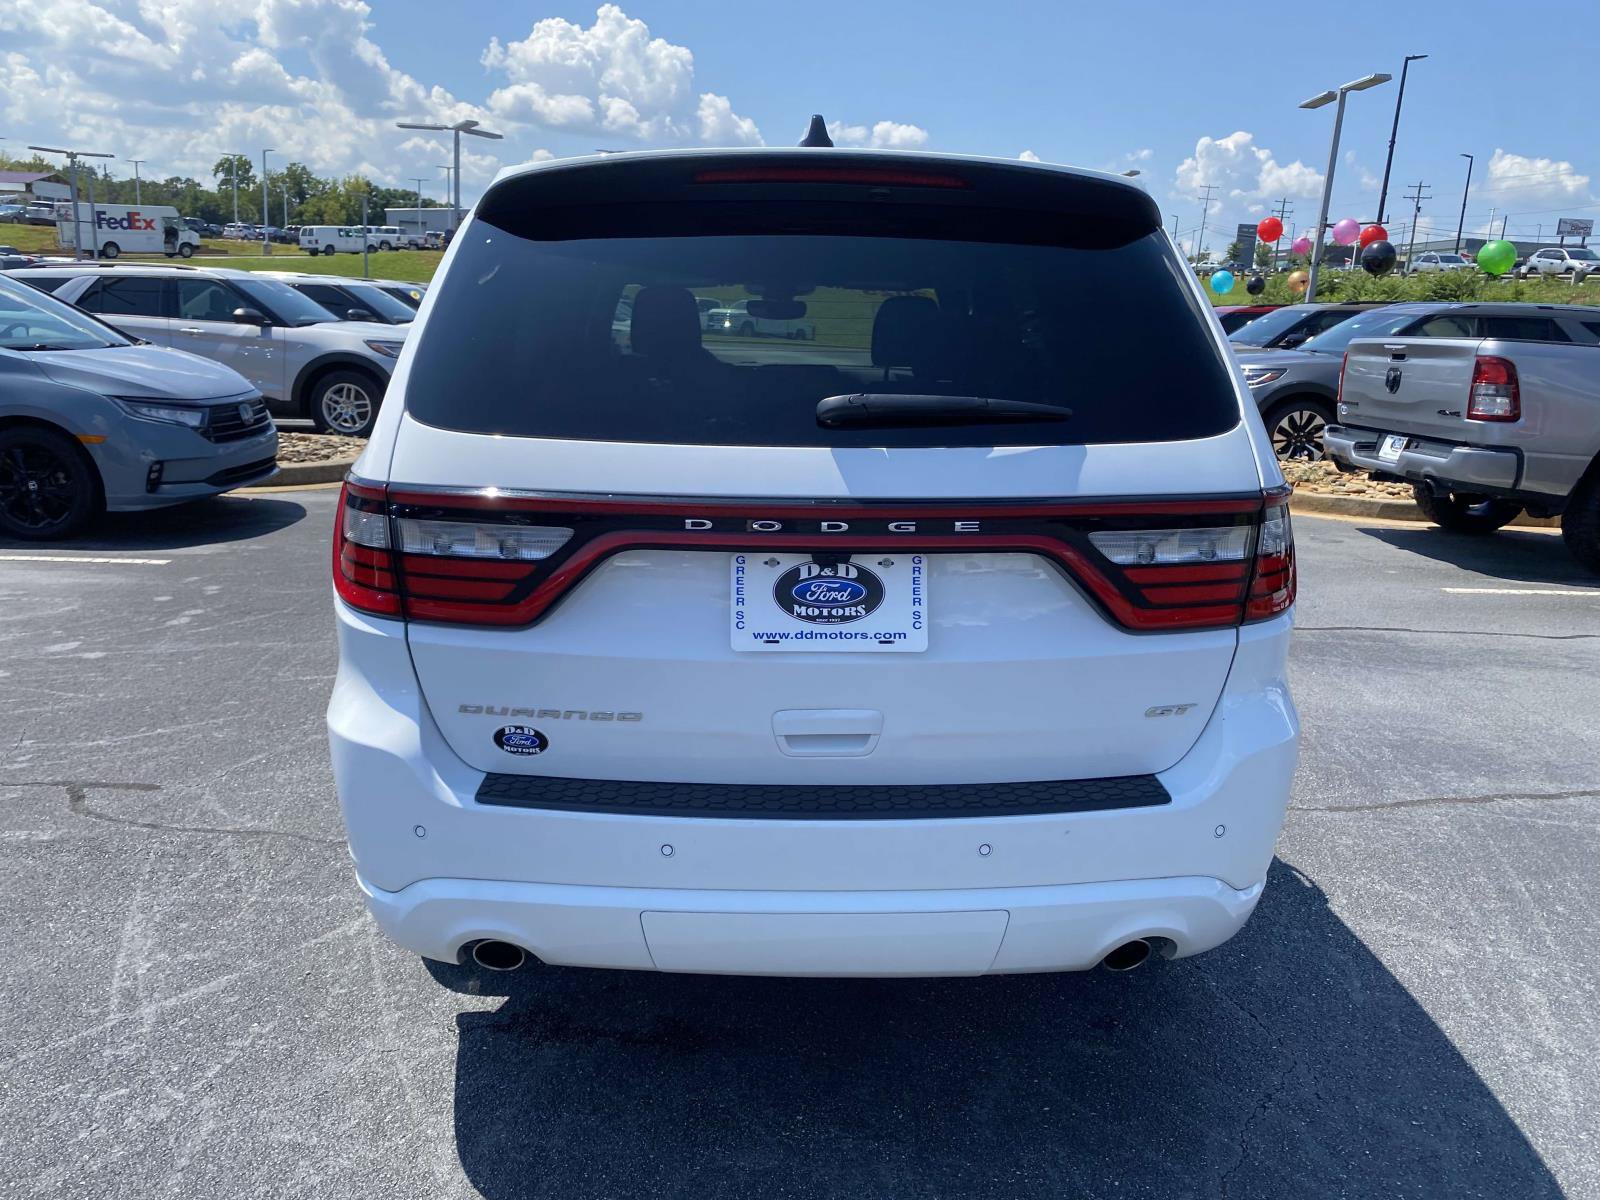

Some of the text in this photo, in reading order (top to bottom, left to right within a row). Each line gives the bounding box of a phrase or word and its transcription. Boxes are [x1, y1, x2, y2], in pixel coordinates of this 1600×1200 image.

[95, 210, 156, 231] FedEx
[685, 519, 980, 532] DODGE
[799, 563, 859, 580] D&D
[735, 555, 746, 630] GREER SC
[806, 582, 852, 601] Ford
[911, 555, 922, 630] GREER SC
[793, 604, 866, 617] MOTORS
[752, 630, 907, 640] www.ddmotors.com
[458, 704, 644, 722] DURANGO
[1144, 703, 1198, 718] GT
[504, 726, 536, 736] D&D
[509, 736, 533, 746] Ford
[503, 745, 542, 753] MOTORS
